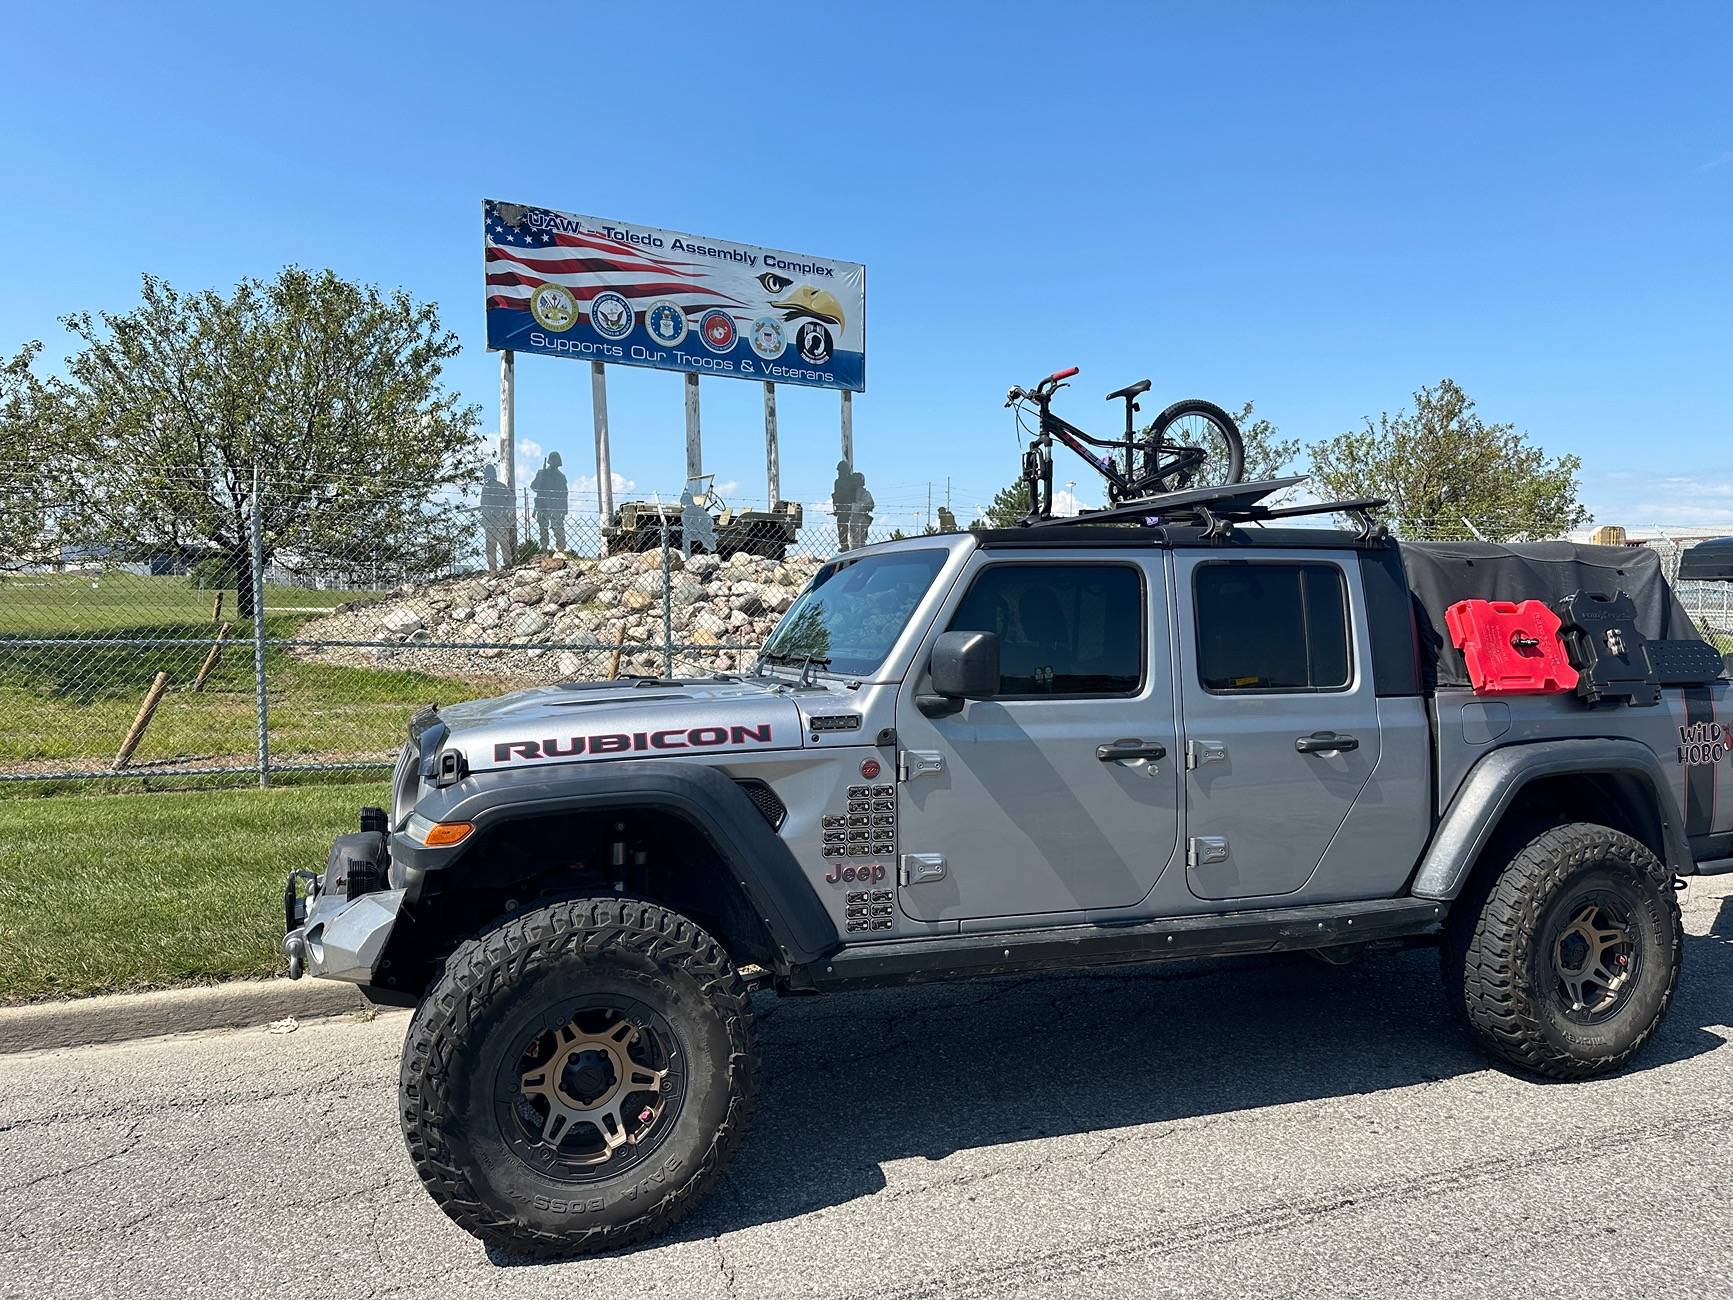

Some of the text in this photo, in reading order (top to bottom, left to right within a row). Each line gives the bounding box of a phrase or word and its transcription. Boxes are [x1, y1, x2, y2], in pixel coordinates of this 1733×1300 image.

[527, 211, 580, 235] UAW
[602, 226, 664, 249] Toledo
[671, 238, 757, 267] Assembly
[763, 254, 834, 278] Complex
[530, 332, 834, 382] Supports Our Troops & Veterans
[494, 723, 772, 762] RUBICON
[1677, 743, 1723, 766] HOBO
[825, 863, 886, 885] Jeep
[621, 1152, 683, 1202] BAJA
[533, 1195, 605, 1214] BOSS
